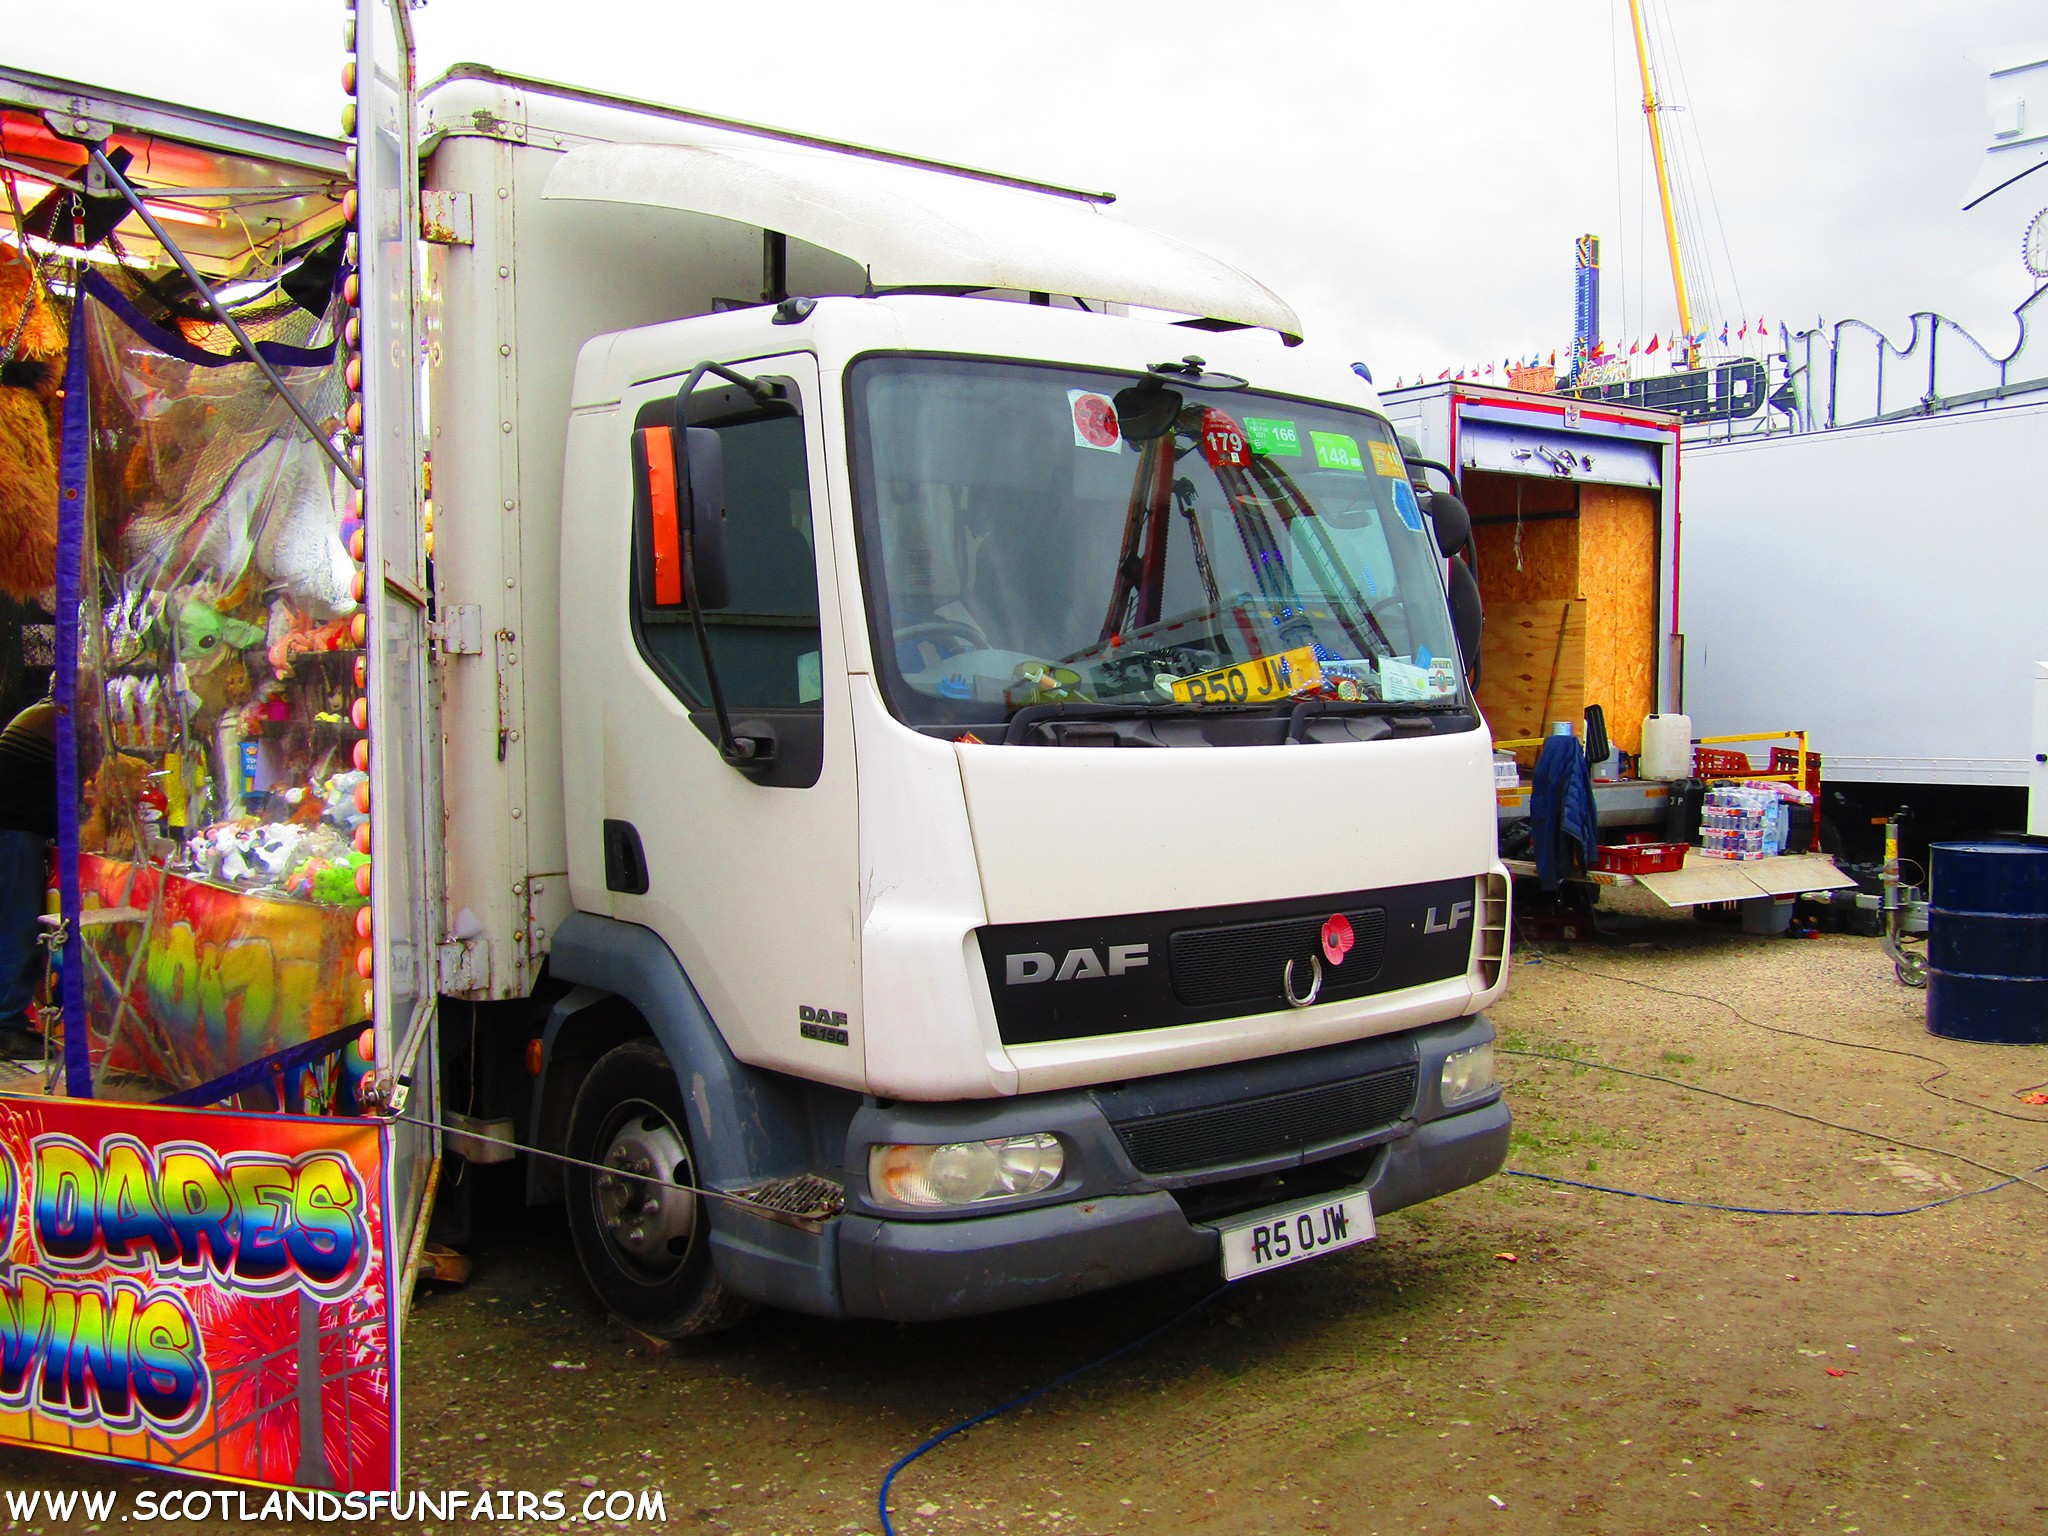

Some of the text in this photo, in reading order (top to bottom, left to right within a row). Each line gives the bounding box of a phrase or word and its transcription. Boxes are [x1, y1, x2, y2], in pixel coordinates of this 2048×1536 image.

[1206, 431, 1243, 452] 179
[1272, 427, 1296, 442] 166
[1319, 446, 1350, 466] 148
[1257, 655, 1293, 696] JW
[1424, 900, 1471, 934] LF
[1006, 943, 1149, 985] DAF
[799, 1004, 848, 1026] DAF
[33, 1135, 368, 1297] DARES
[1253, 1220, 1292, 1264] R5
